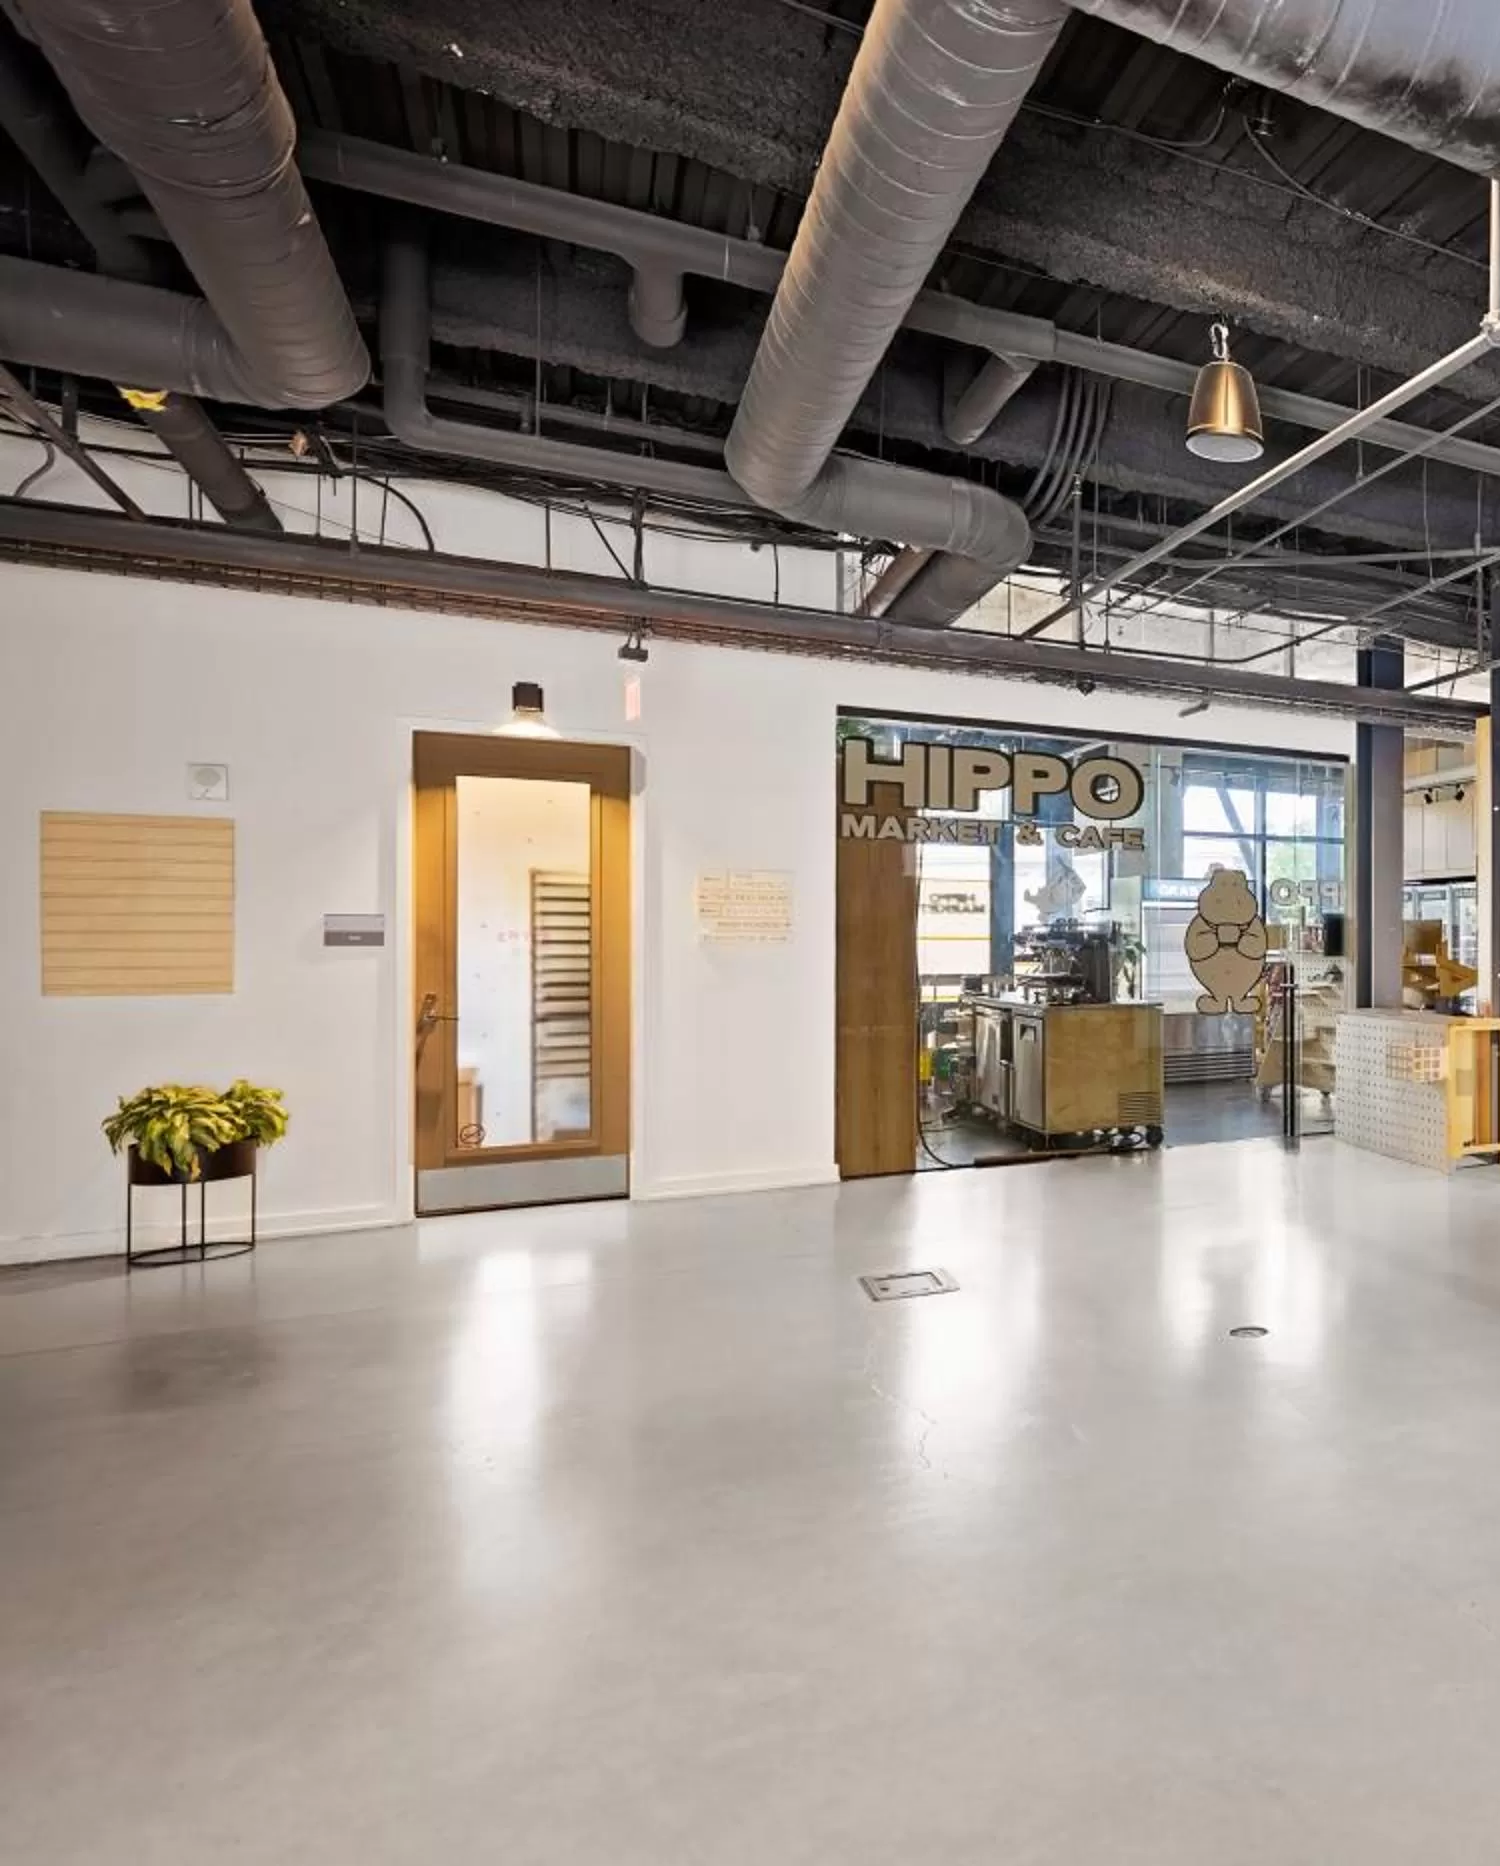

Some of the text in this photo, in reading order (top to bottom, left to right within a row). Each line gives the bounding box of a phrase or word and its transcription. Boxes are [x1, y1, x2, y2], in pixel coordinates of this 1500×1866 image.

[841, 736, 1145, 820] HIPPO
[840, 811, 1146, 851] MARKET & CAFE
